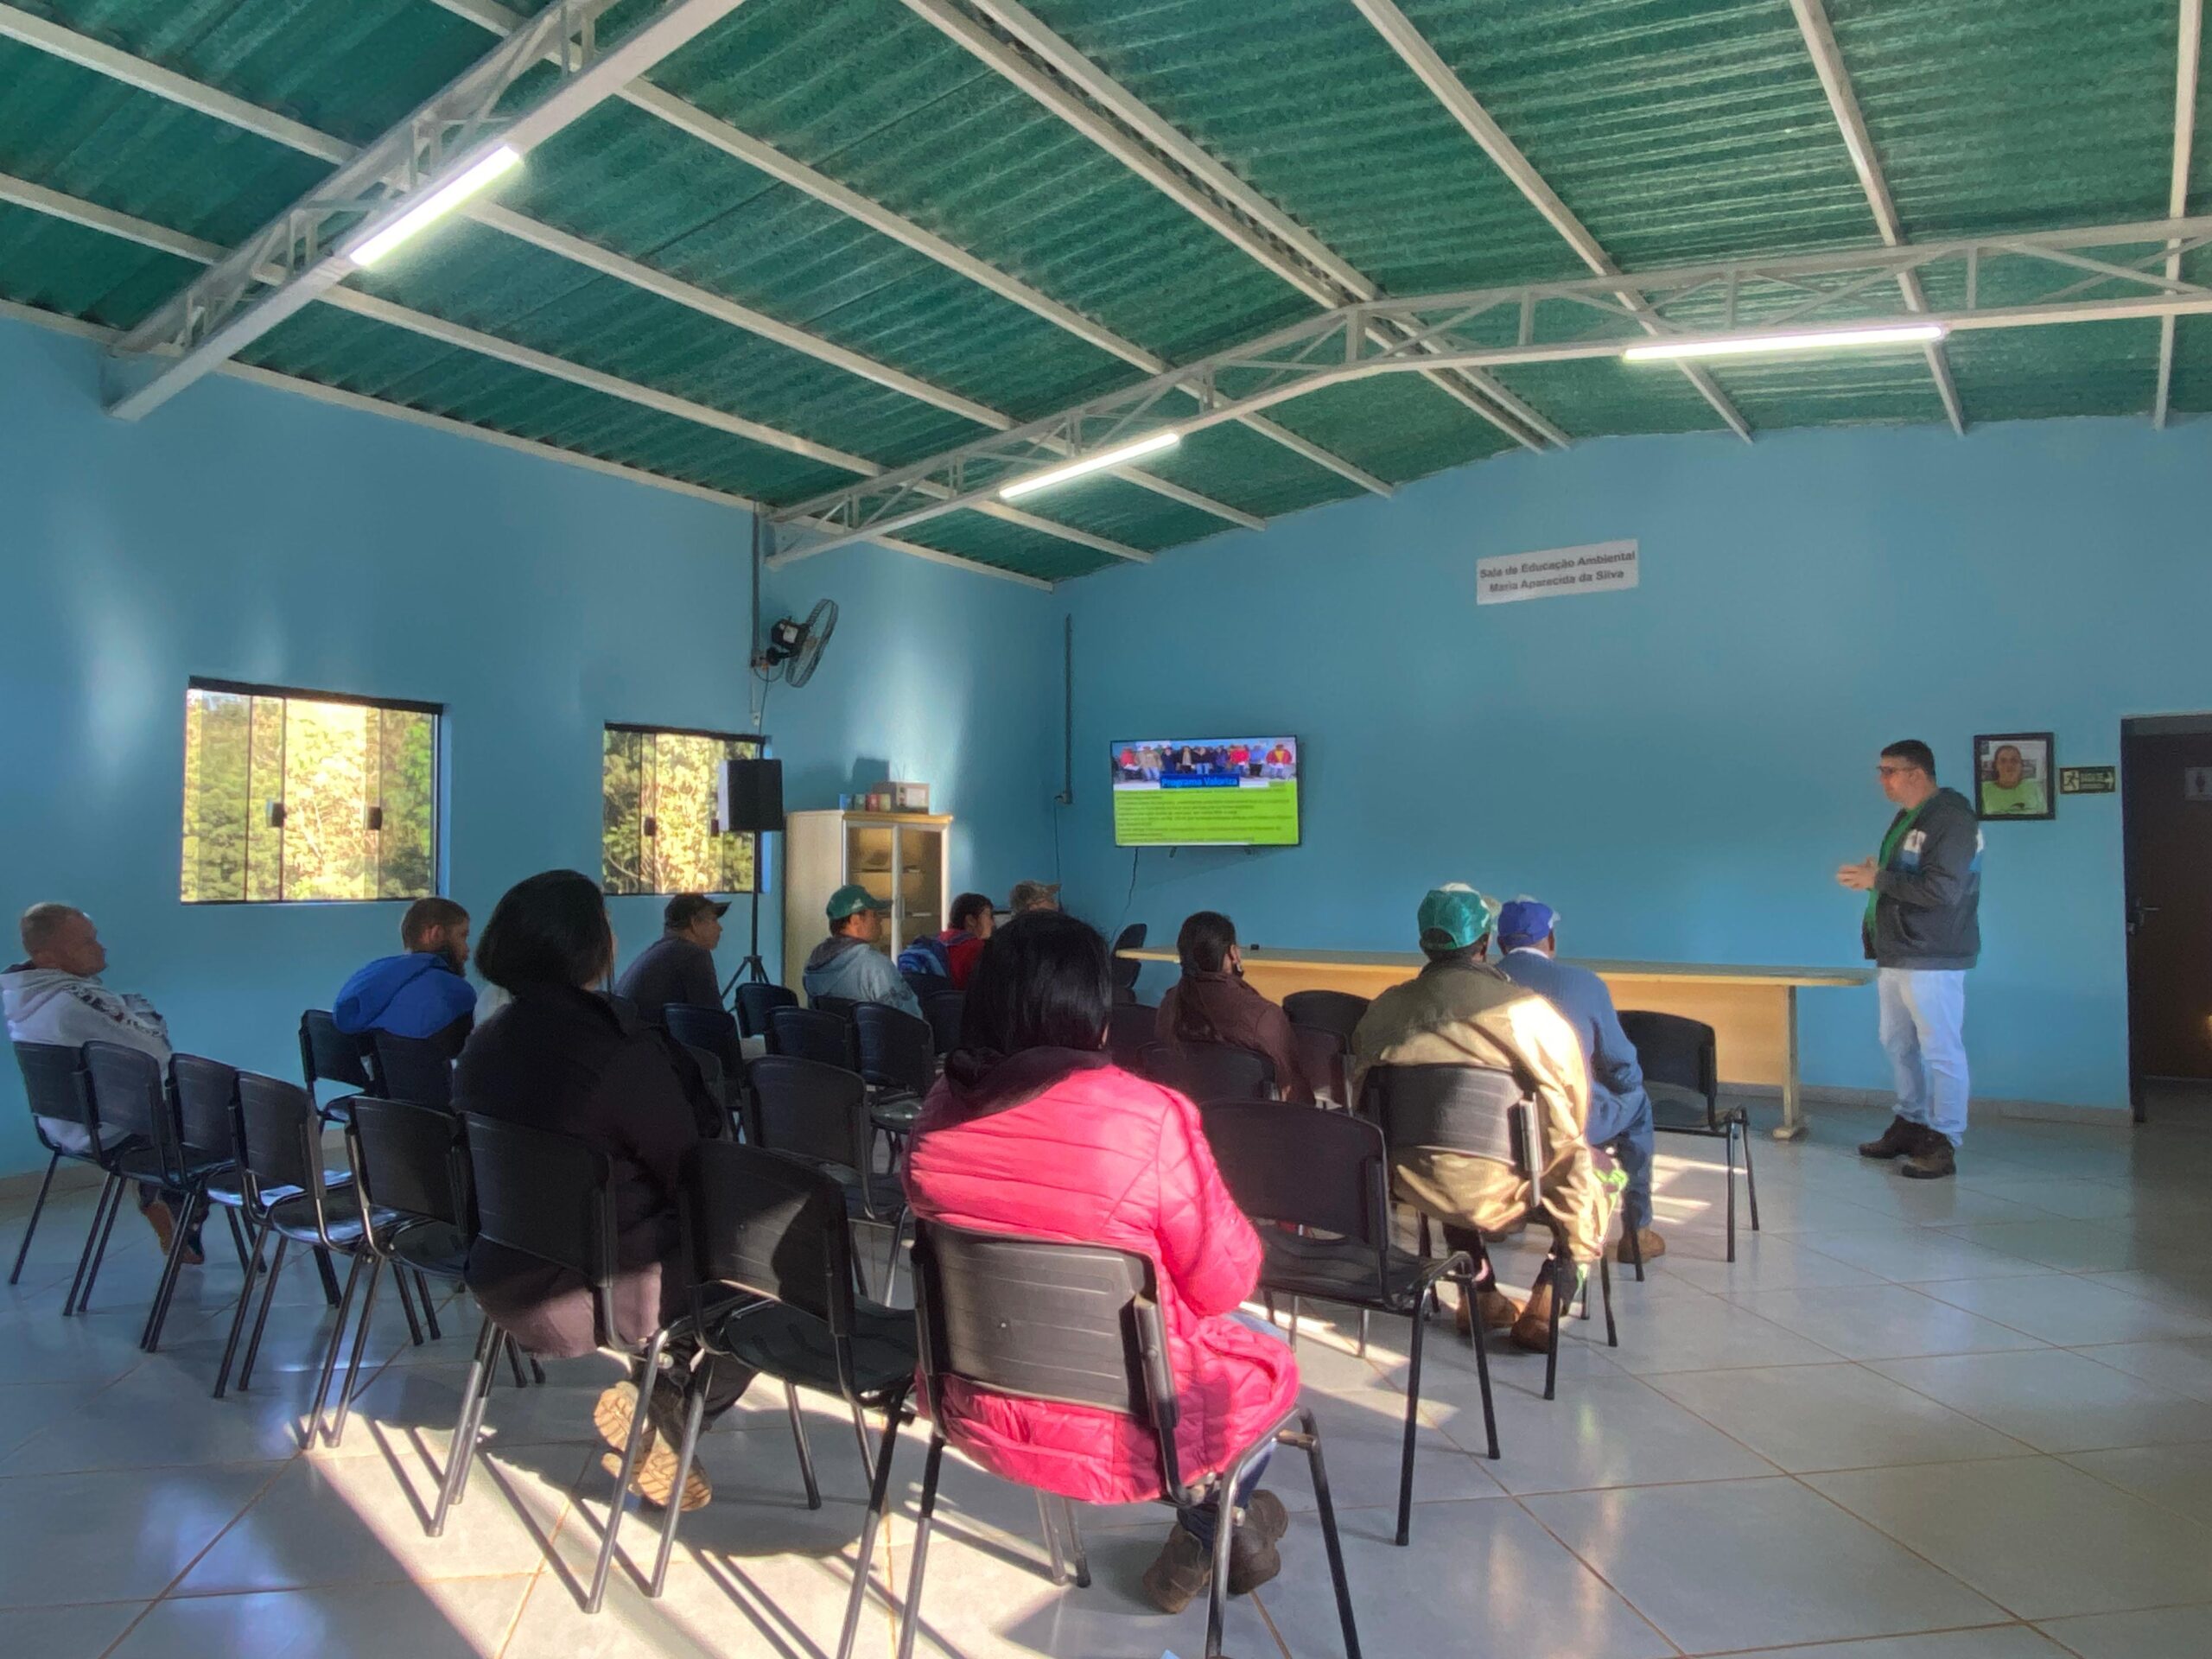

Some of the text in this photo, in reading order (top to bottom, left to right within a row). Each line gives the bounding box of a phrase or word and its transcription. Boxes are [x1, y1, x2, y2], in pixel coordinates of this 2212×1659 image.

[1479, 550, 1636, 579] Sala de Educação Ambiental
[1489, 569, 1624, 593] Maria Aparecida da Silva
